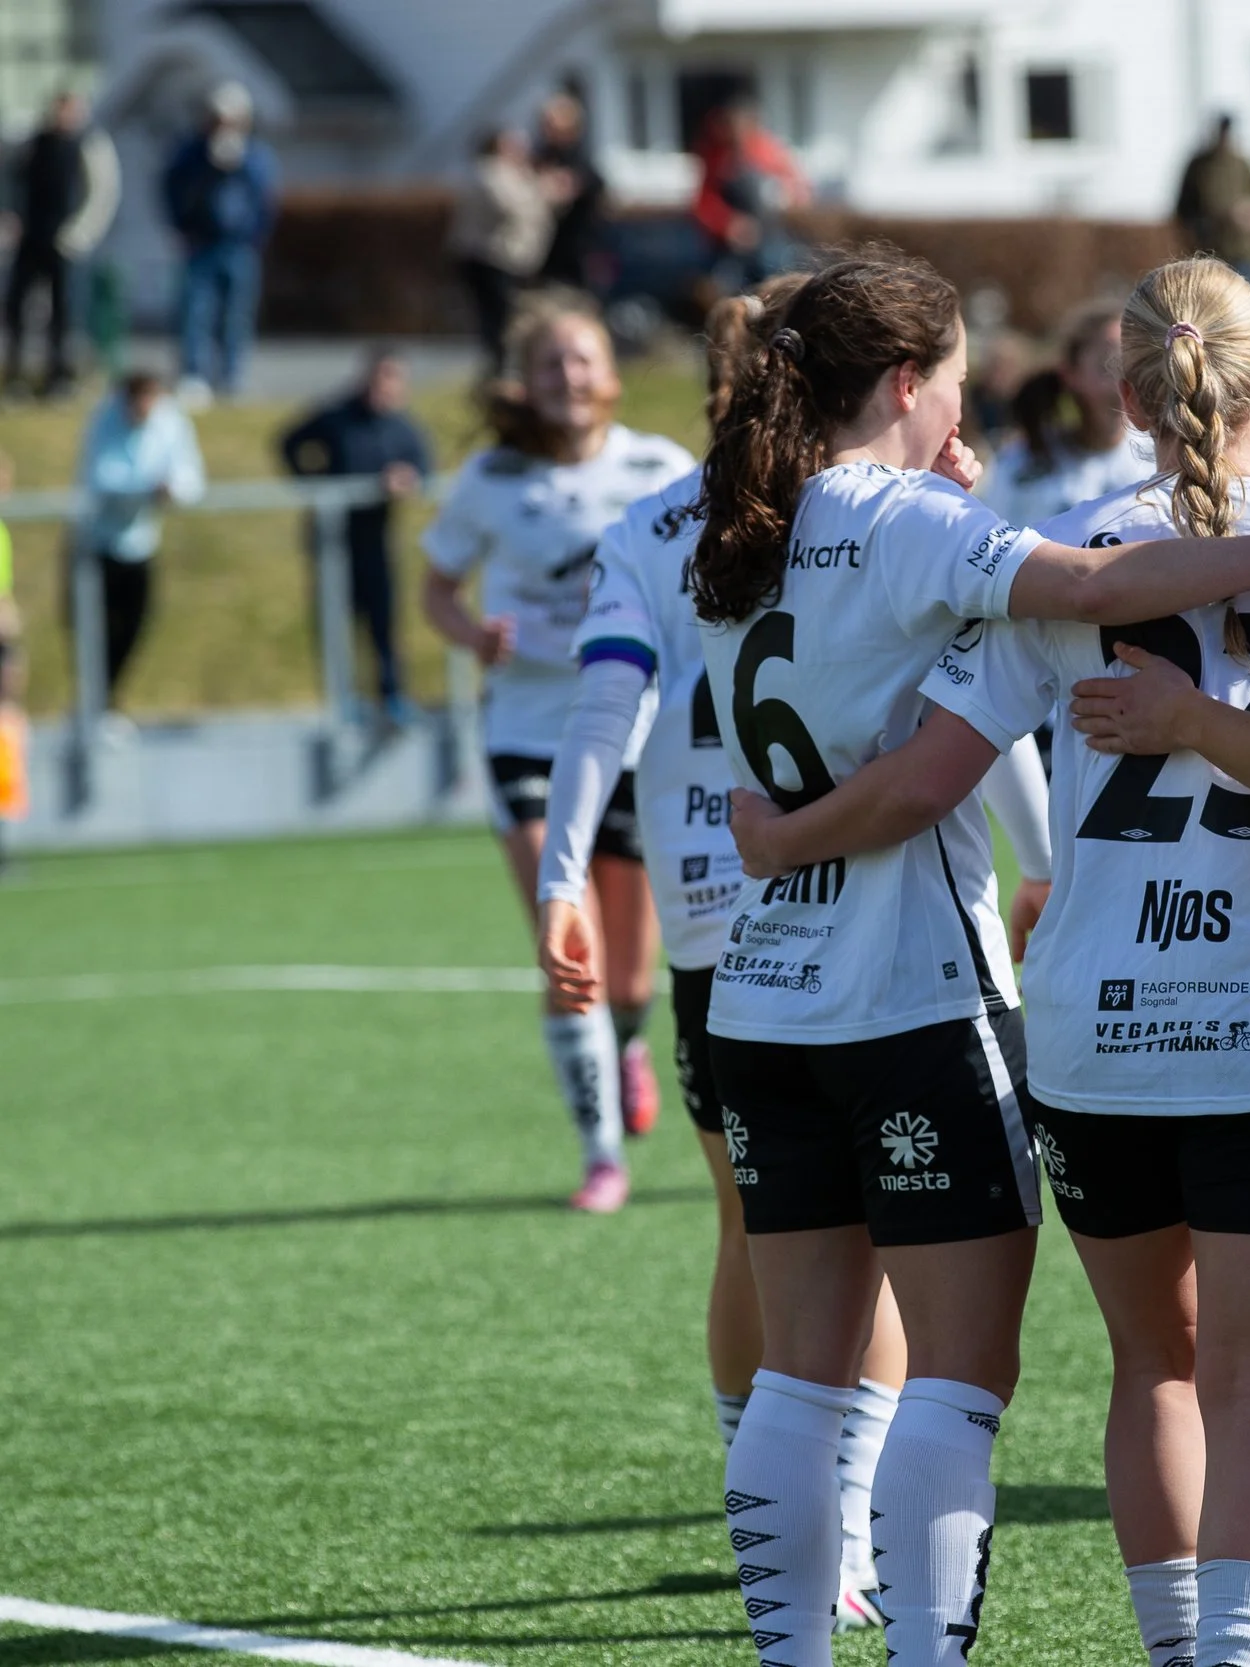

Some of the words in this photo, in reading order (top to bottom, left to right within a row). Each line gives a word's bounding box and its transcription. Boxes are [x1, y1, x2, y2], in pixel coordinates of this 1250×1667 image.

[785, 538, 861, 569] kraft
[937, 654, 975, 685] Sogn
[733, 611, 836, 813] 6
[1135, 878, 1233, 952] Njøs
[745, 934, 780, 947] Sogndal
[720, 951, 798, 972] EGARD'S
[1140, 996, 1178, 1009] Sogndal
[1095, 1030, 1221, 1054] KREFTTRÅKK
[879, 1170, 951, 1192] mesta
